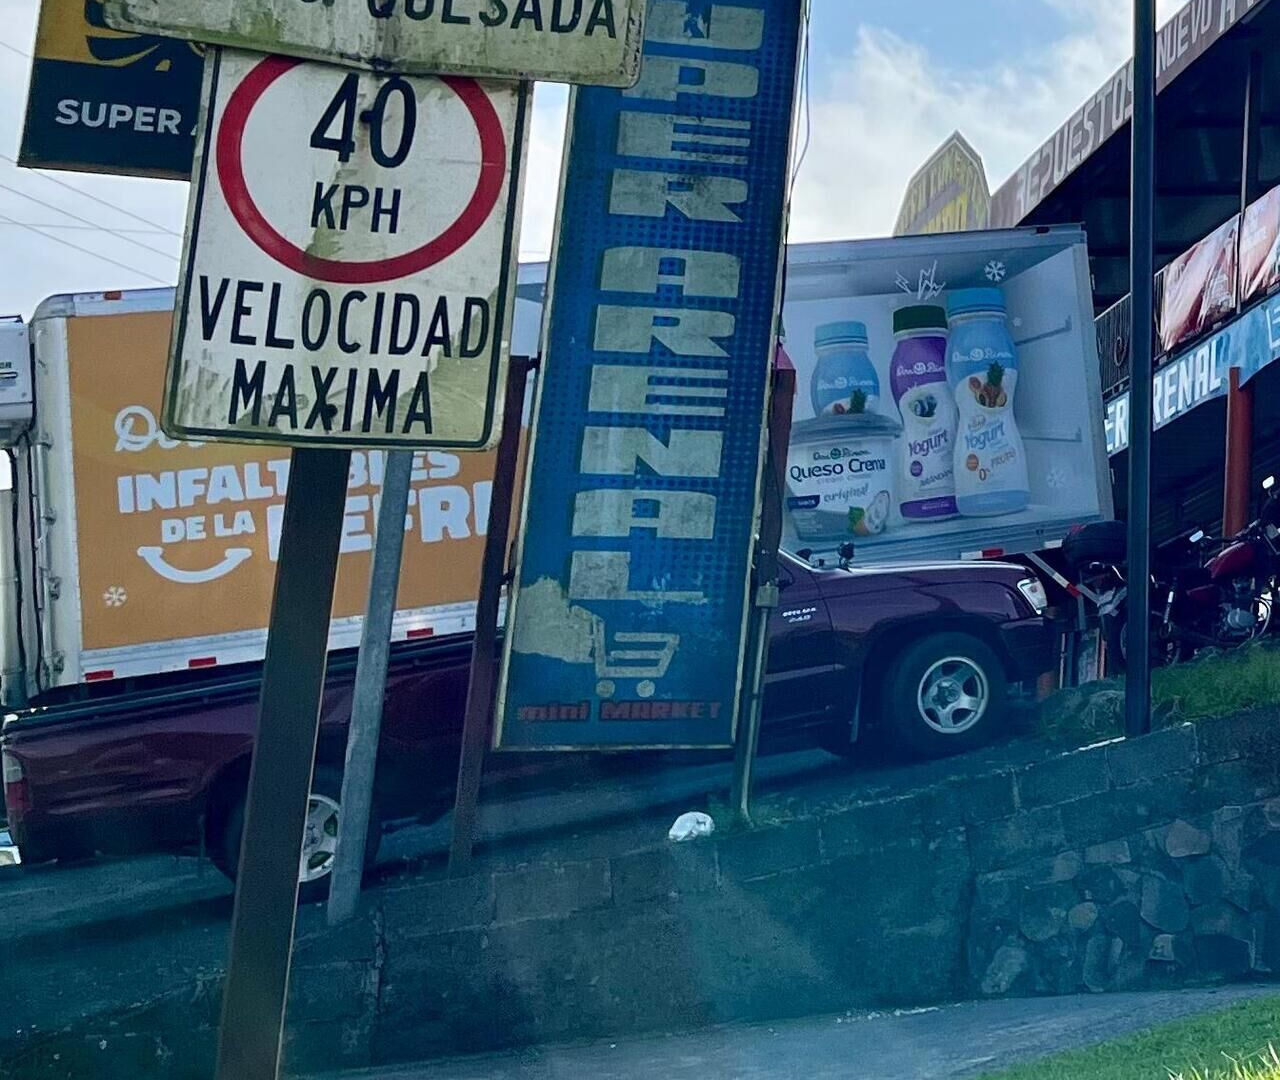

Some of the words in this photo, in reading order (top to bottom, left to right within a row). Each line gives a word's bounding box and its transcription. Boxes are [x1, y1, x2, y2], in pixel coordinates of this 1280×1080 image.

[55, 98, 183, 137] SUPER
[309, 72, 417, 168] 40
[311, 181, 402, 234] KPH
[200, 274, 491, 360] VELOCIDAD
[228, 358, 434, 435] MAXIMA
[1153, 339, 1222, 424] RENAL
[568, 246, 743, 606] ARENAL
[908, 428, 948, 457] Yogurt
[965, 421, 1006, 451] Yogurt
[117, 449, 460, 514] INFALTBLES
[790, 463, 844, 483] Queso
[848, 458, 885, 472] Crema
[161, 517, 207, 544] DE
[213, 509, 256, 538] LA
[266, 479, 493, 563] ERI
[601, 700, 722, 720] MARKET
